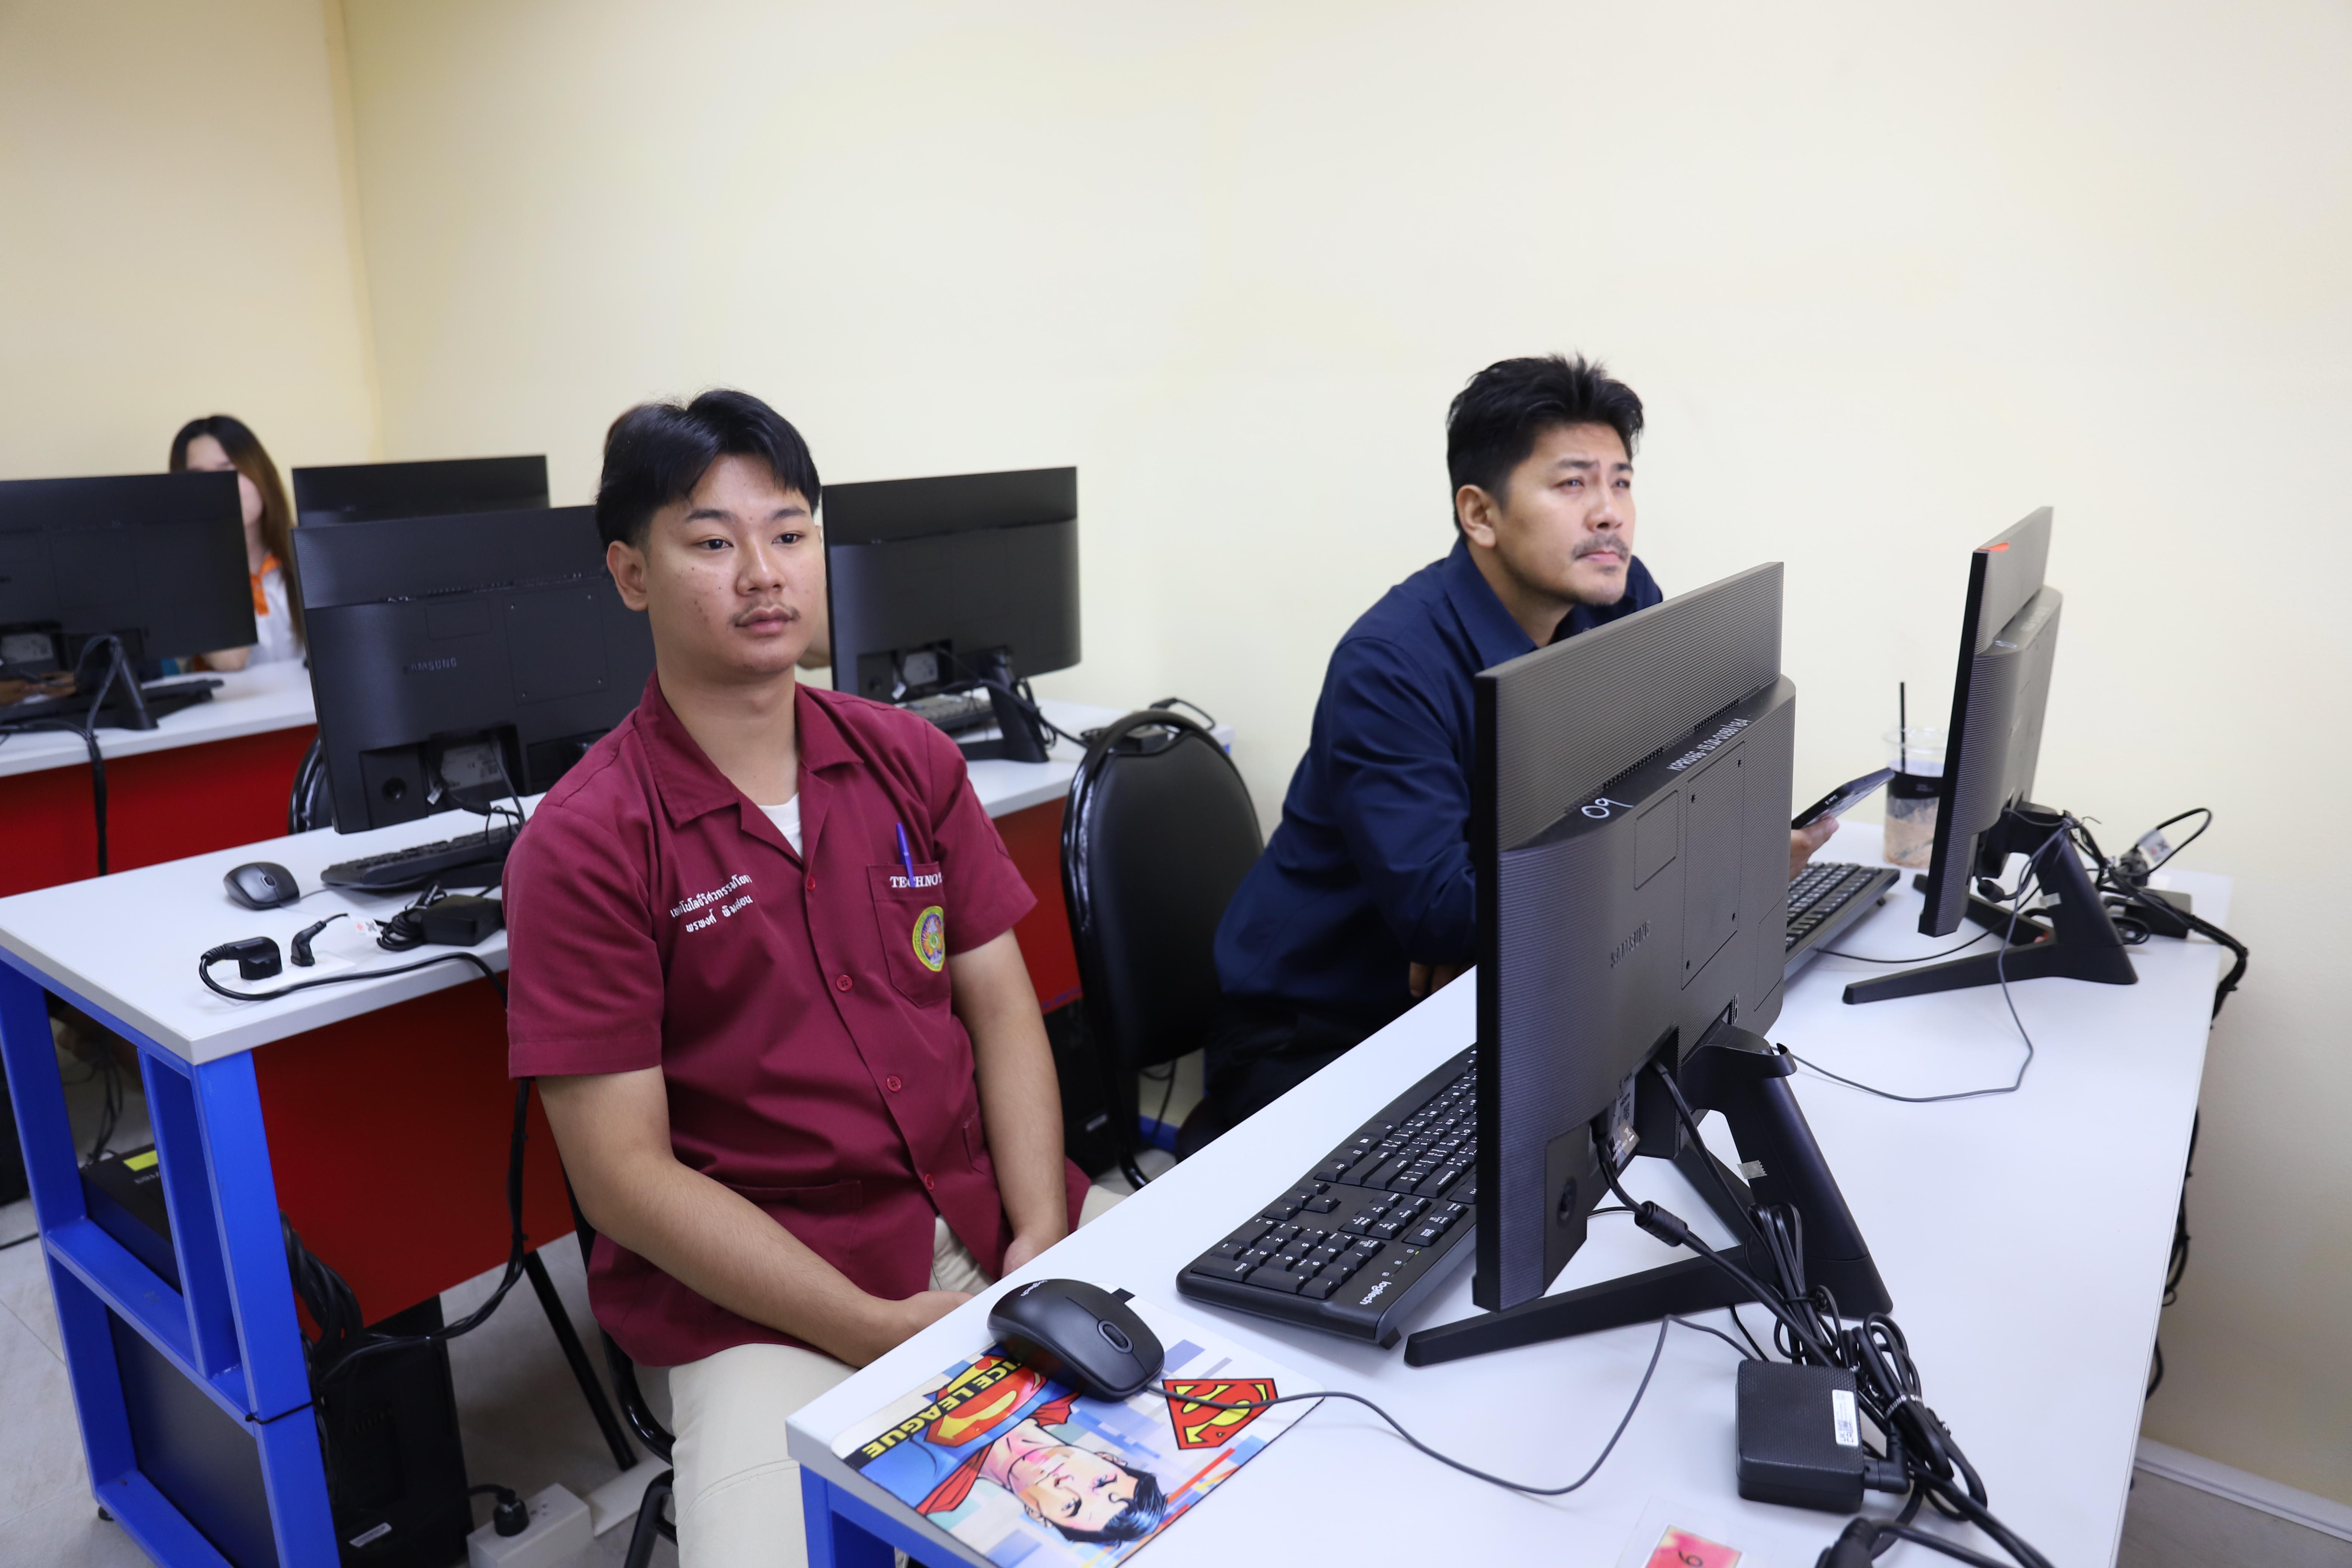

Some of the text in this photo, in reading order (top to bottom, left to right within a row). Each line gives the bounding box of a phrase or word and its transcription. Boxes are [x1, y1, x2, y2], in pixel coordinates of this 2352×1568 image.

[1581, 797, 1634, 819] 09
[1611, 921, 1650, 968] SAMSUNG
[1437, 1171, 1455, 1185] Backspace
[1235, 1263, 1247, 1272] Enter
[1360, 1281, 1392, 1305] logitech
[862, 1361, 1021, 1458] ICE LEAGUE
